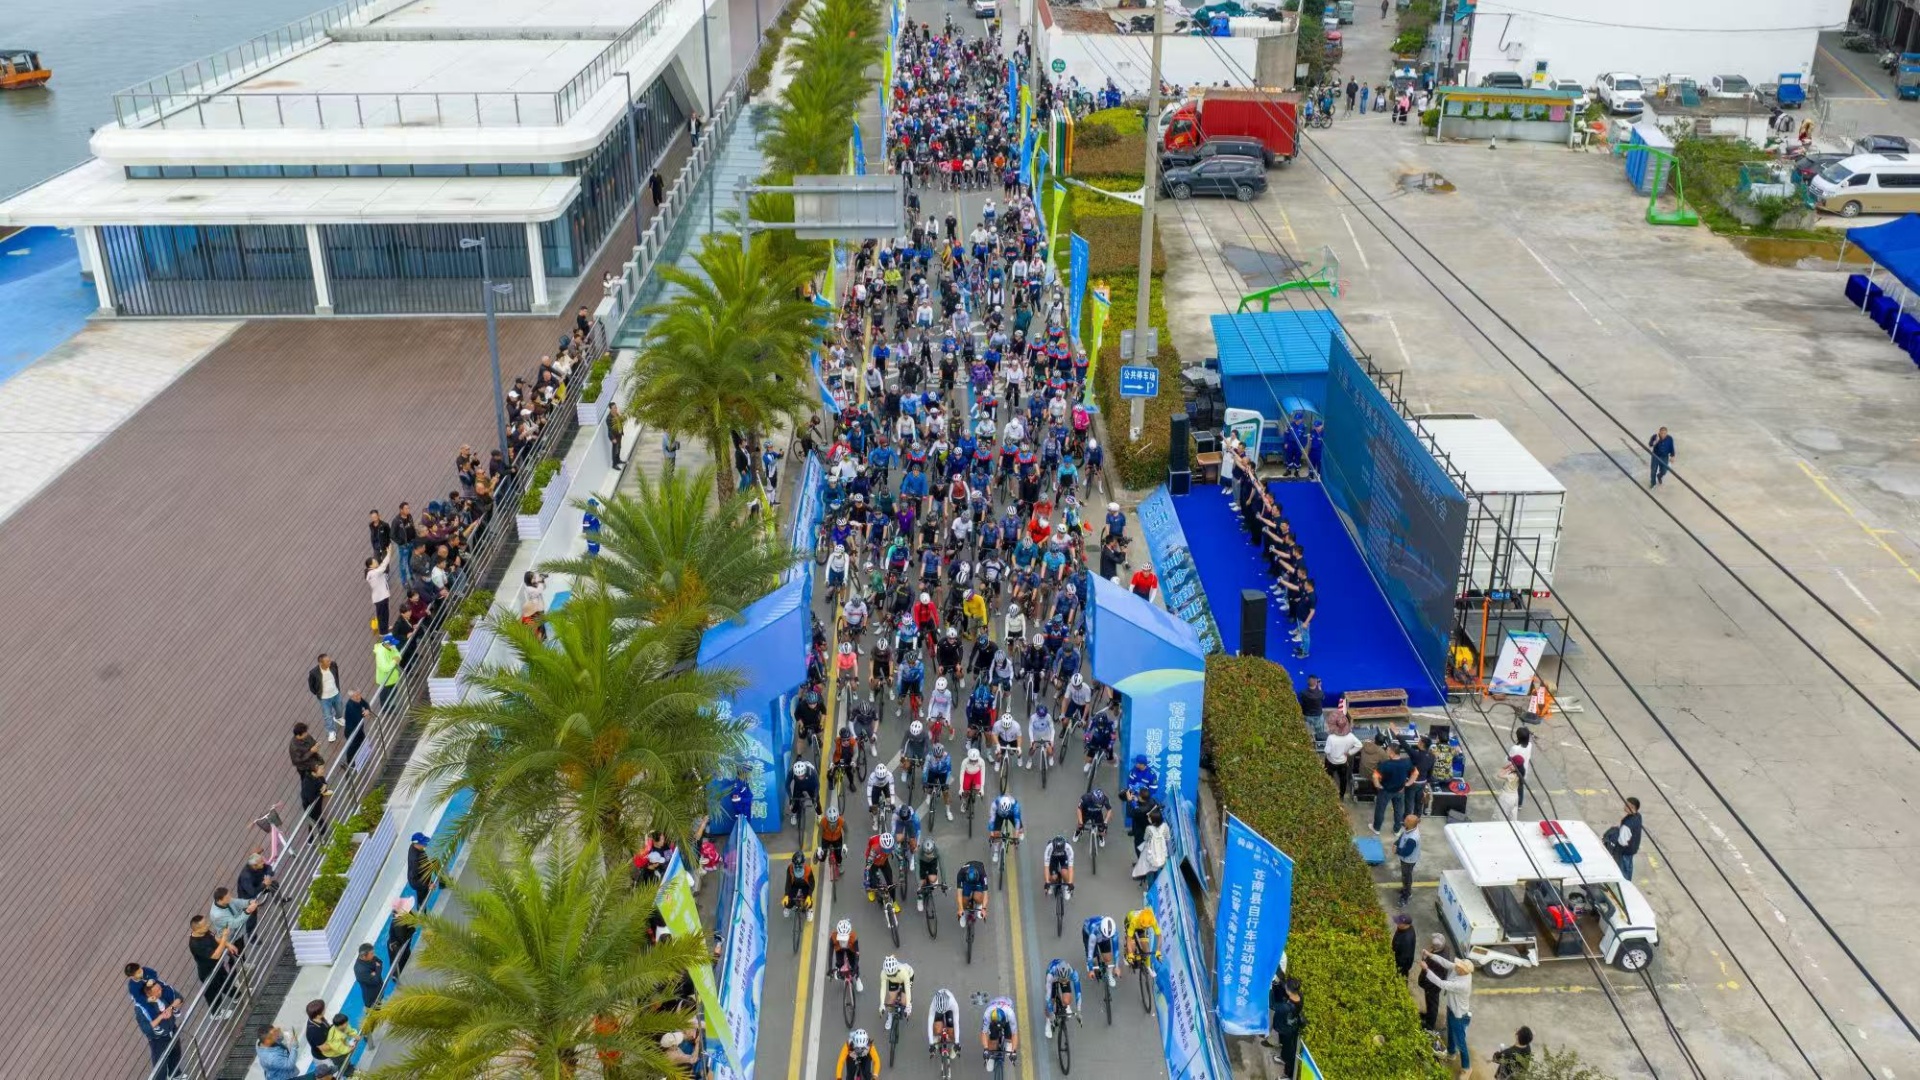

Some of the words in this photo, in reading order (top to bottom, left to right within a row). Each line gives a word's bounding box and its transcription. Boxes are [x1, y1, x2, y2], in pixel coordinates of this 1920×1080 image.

[1124, 370, 1156, 381] 公共停车场
[1146, 382, 1155, 393] P
[1236, 868, 1266, 1007] 苍南县自行车运动健身协会
